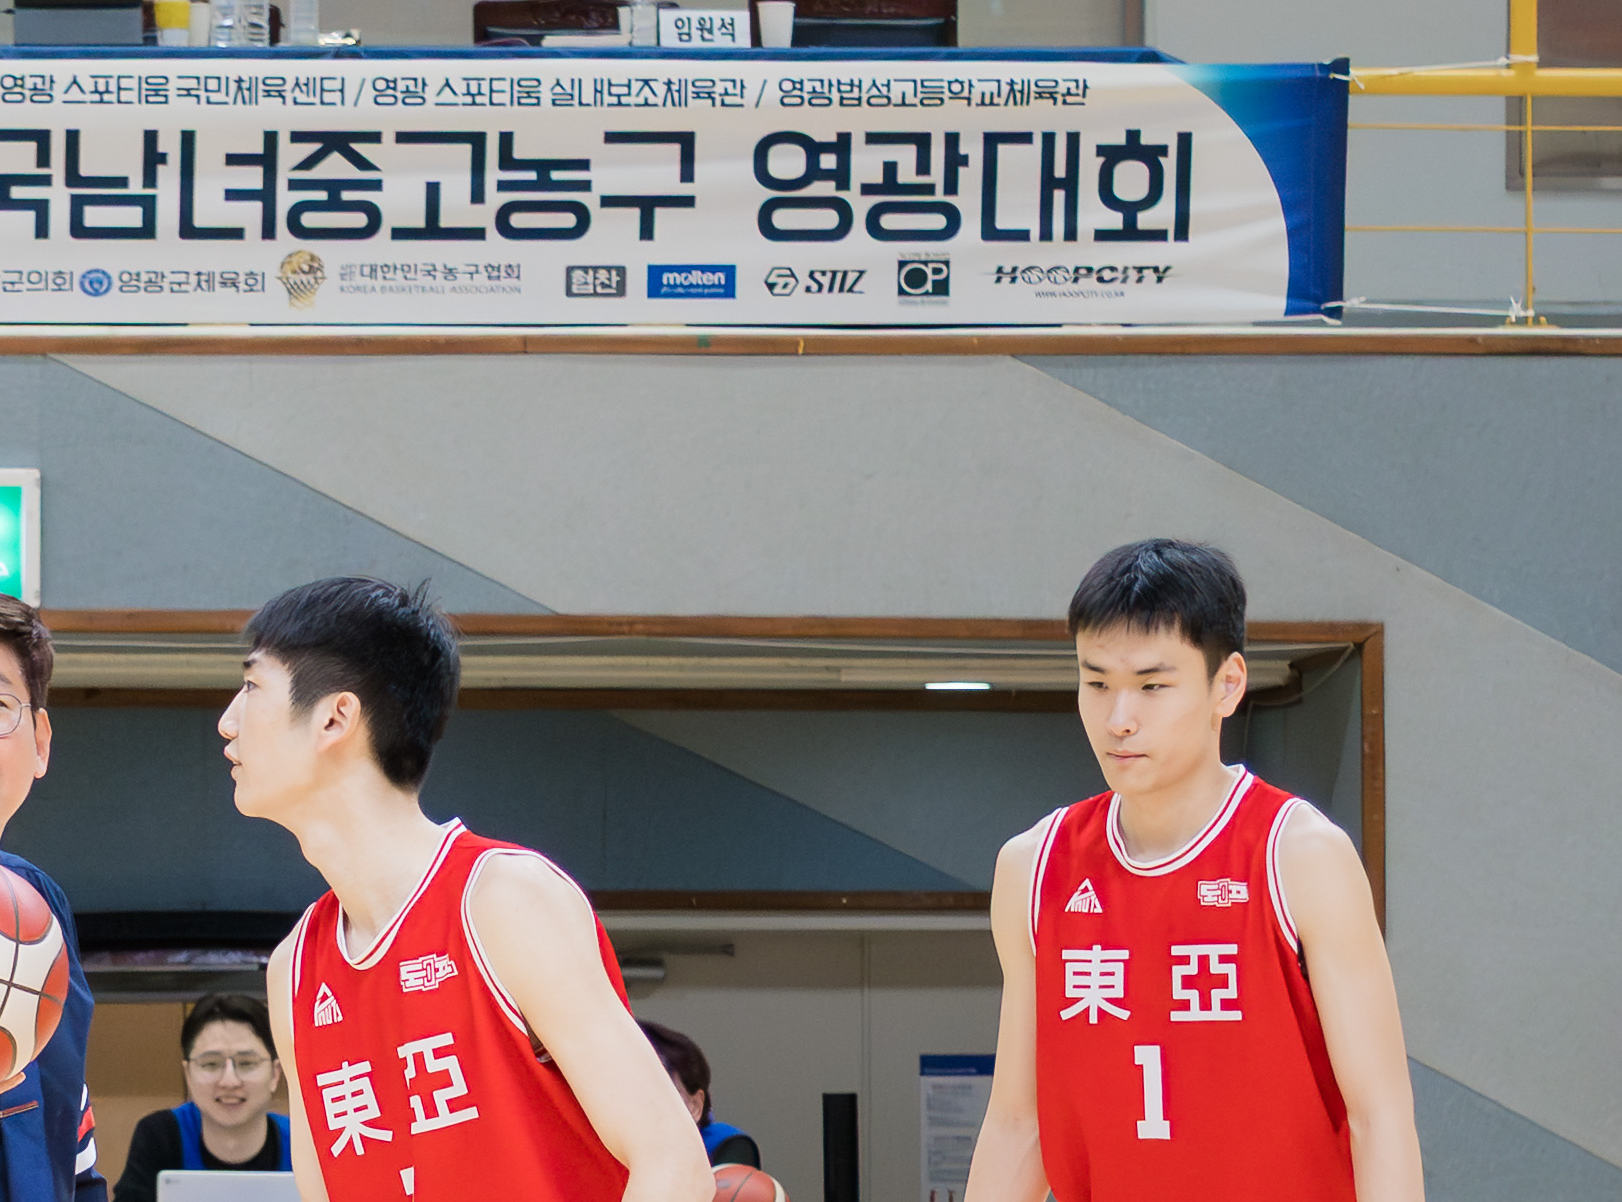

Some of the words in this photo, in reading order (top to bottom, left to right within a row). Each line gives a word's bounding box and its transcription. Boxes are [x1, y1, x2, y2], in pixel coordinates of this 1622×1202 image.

[674, 16, 737, 43] 임원석
[0, 73, 56, 105] 영광
[62, 74, 170, 105] 스포티움
[175, 75, 346, 107] 국민체육센터
[354, 77, 366, 108] /
[371, 76, 428, 107] 영광
[435, 77, 542, 108] 스포티움
[550, 77, 747, 109] 실내보조체육관
[755, 78, 767, 109] /
[778, 77, 1090, 108] 영광법성고등학교체육관
[753, 129, 1193, 243] 영광대회
[118, 270, 266, 294] 영광군체육회
[359, 262, 521, 282] 대한민국농구협회
[571, 268, 621, 294] 협찬
[661, 270, 726, 286] molten
[804, 269, 867, 294] STIZ
[994, 265, 1173, 285] HOOPCITY
[1133, 1045, 1171, 1140] 1
